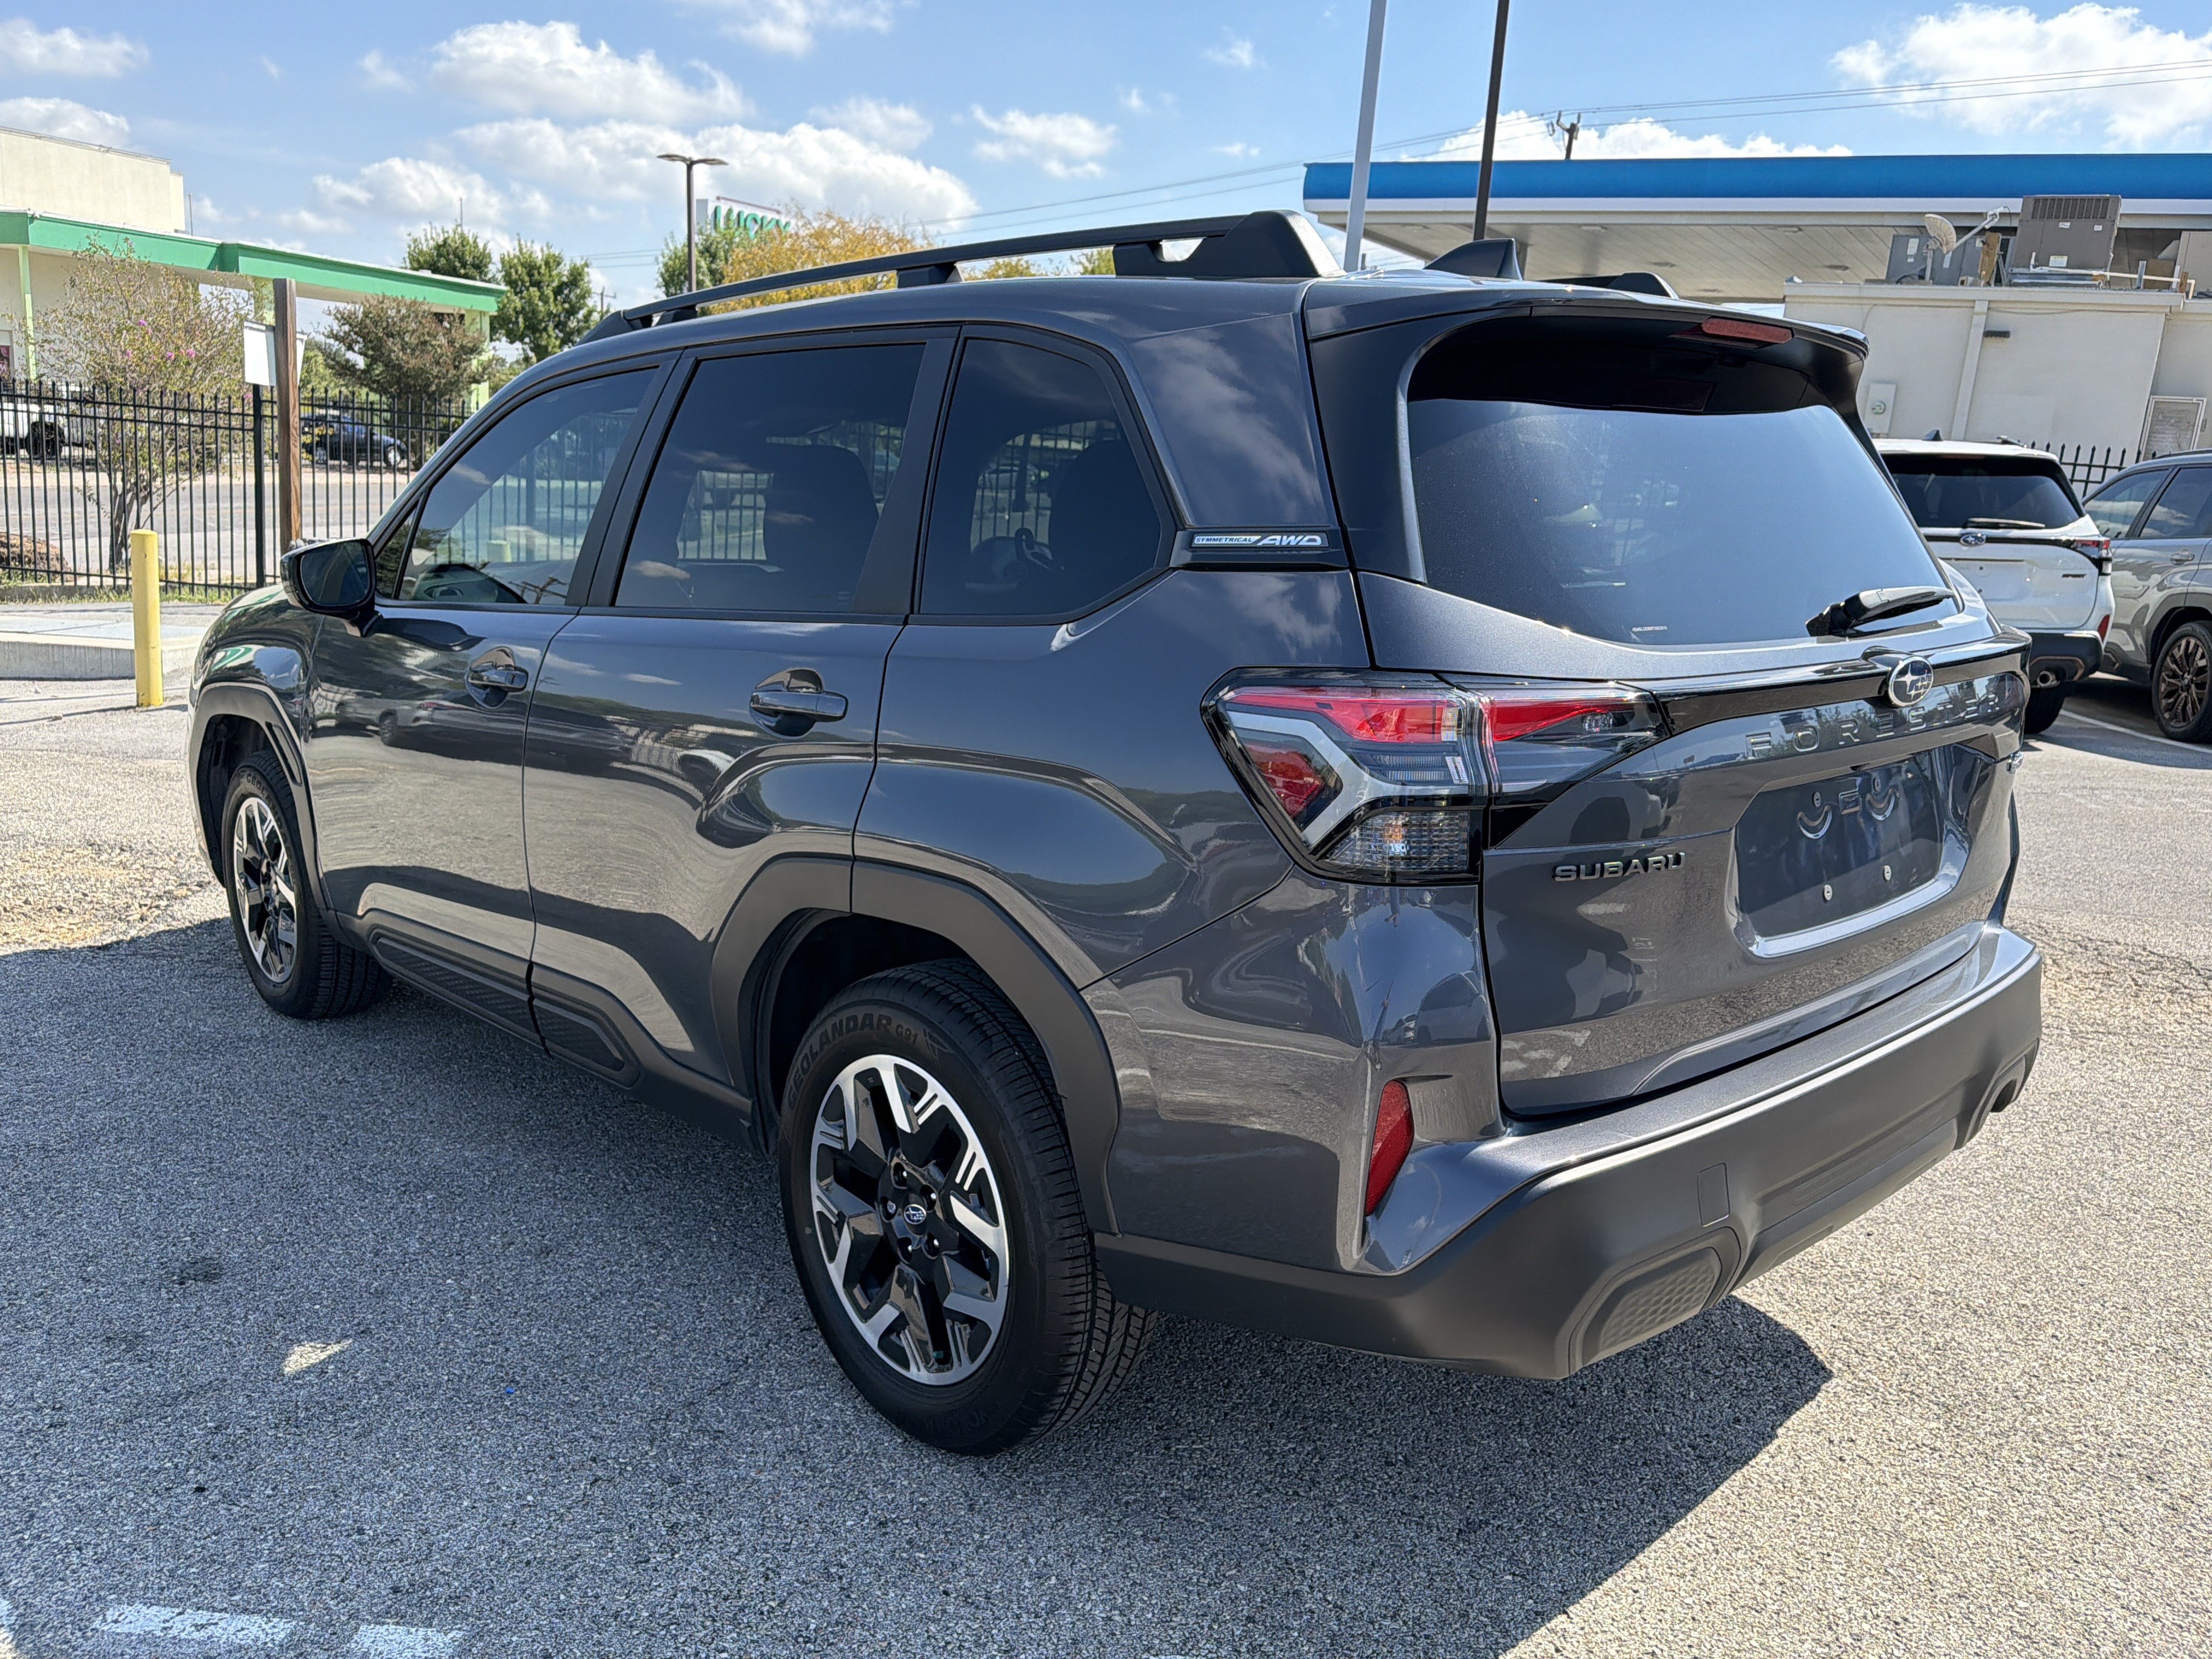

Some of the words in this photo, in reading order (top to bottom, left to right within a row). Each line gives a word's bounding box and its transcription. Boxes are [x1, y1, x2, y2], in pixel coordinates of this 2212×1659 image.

[1256, 535, 1322, 546] AWD
[1745, 692, 2000, 760] FORESTER
[1553, 852, 1685, 882] SUBARU
[787, 1013, 893, 1109] GEOLANDAR
